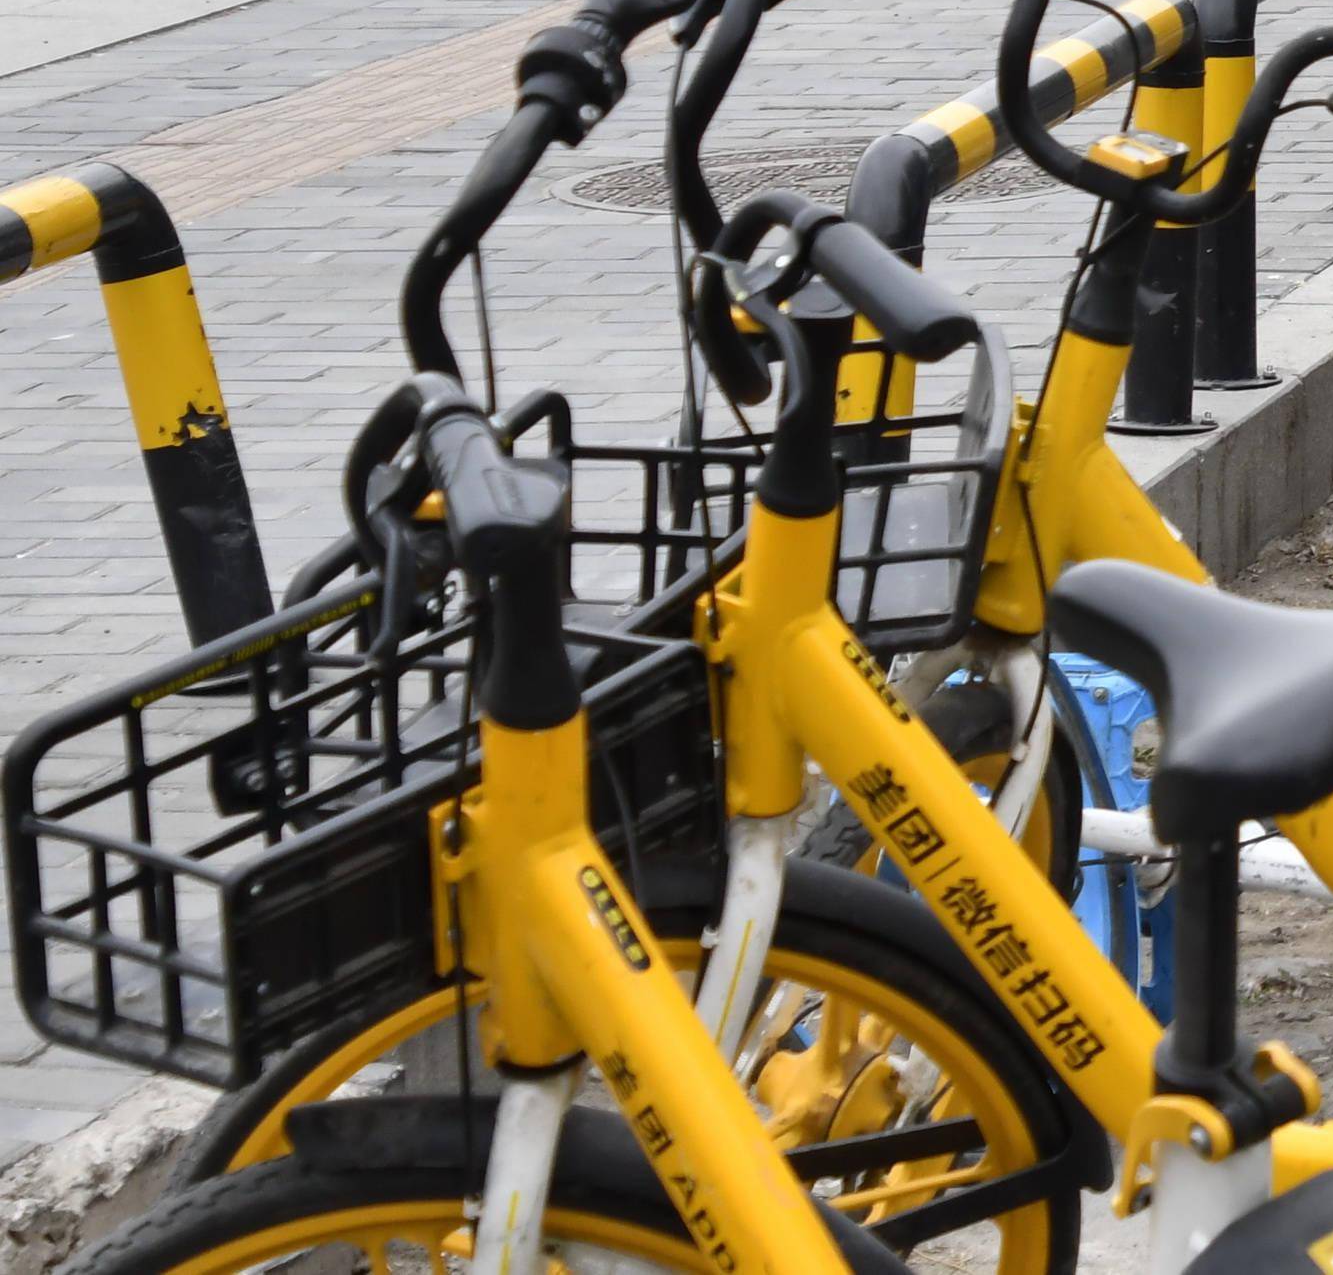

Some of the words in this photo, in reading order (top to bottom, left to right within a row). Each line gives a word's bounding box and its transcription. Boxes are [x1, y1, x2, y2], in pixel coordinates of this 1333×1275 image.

[848, 762, 947, 866] 美团
[938, 875, 1107, 1073] 微信扫码
